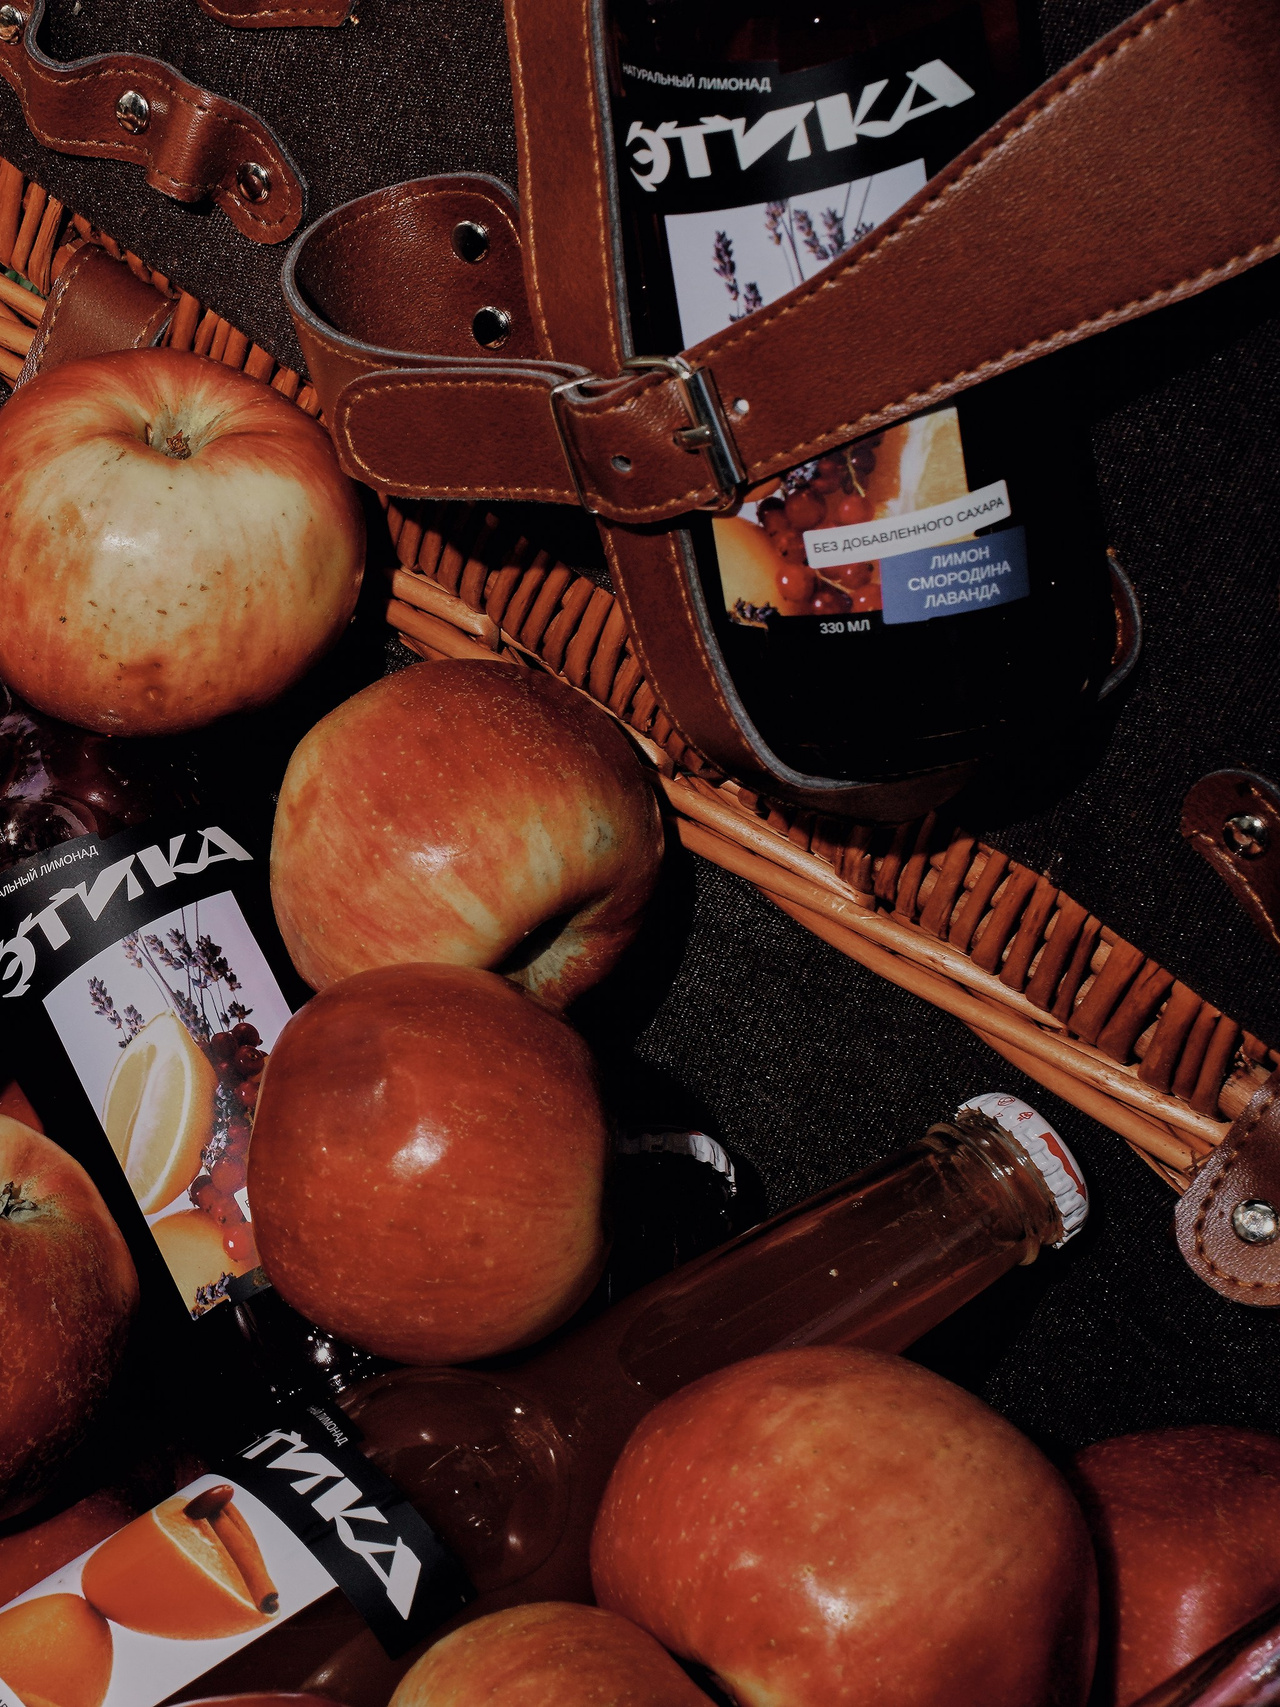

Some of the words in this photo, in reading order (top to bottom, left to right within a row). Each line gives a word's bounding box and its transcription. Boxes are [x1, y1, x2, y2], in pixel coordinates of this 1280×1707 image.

[622, 62, 696, 89] НАТУРАЛЬНЫЙ
[697, 76, 772, 94] ЛИМОНАД
[625, 58, 976, 192] ЭТИКА
[813, 541, 839, 554] БЕЗ
[842, 515, 954, 552] ДОБАВЛЕННОГО
[957, 497, 1005, 522] САХАРА
[930, 545, 991, 570] ЛИМОН
[907, 560, 1012, 591] СМОРОДИНА
[923, 582, 1001, 609] ЛАВАНДА
[819, 622, 844, 635] 330
[847, 619, 871, 633] МЛ
[40, 845, 99, 877] ЛИМОНАД
[316, 1411, 349, 1447] ЛИМОНАД
[235, 1429, 422, 1620] ТИКА
